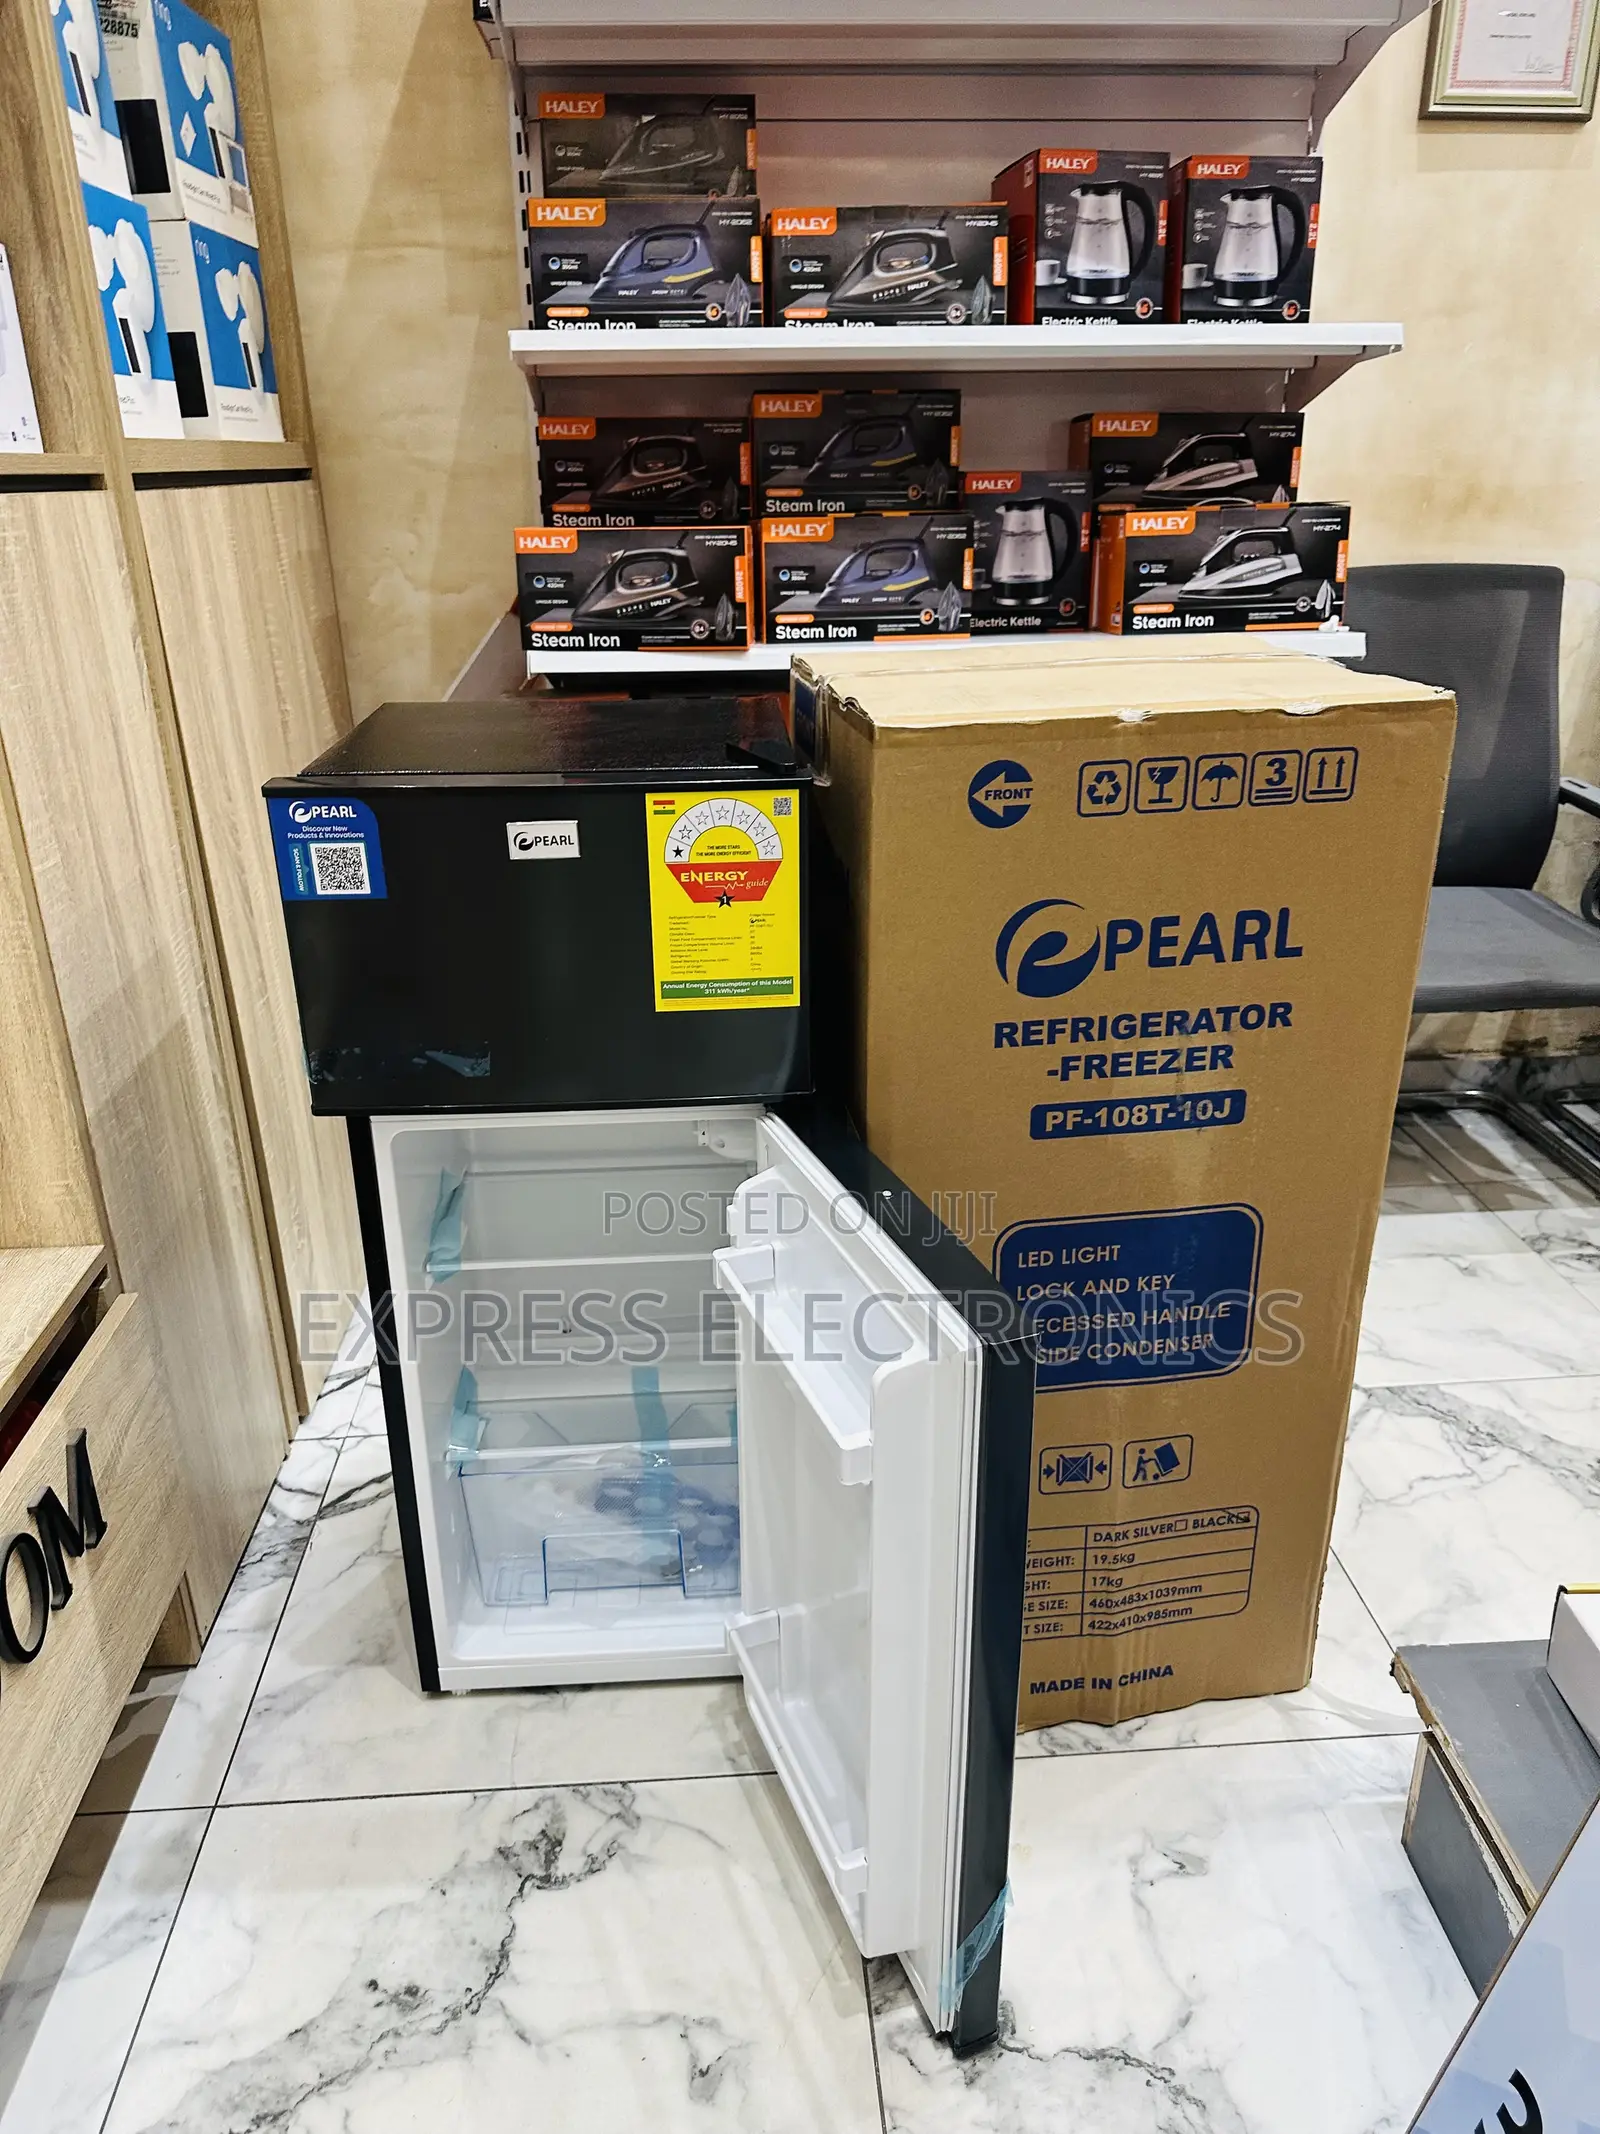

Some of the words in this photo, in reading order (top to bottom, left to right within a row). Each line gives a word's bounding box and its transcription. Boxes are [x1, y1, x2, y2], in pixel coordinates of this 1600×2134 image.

[545, 100, 599, 113] HALEY
[1046, 157, 1090, 170] HALEY
[1196, 163, 1242, 175] HALEY
[536, 205, 599, 221] HALEY
[777, 216, 832, 231] HALEY
[907, 281, 930, 292] HALEY
[761, 399, 816, 413] HALEY
[542, 424, 590, 435] HALEY
[1099, 419, 1152, 433] HALEY
[972, 479, 1015, 491] HALEY
[766, 499, 814, 513] Steam
[817, 498, 846, 512] Iron
[553, 514, 602, 527] Steam
[606, 513, 635, 527] Iron
[1132, 516, 1189, 531] HALEY
[771, 523, 828, 538] HALEY
[519, 536, 573, 549] HALEY
[650, 597, 672, 607] HALEY
[970, 616, 1008, 628] Electric
[1009, 615, 1042, 627] Kettle
[1132, 614, 1181, 630] Steam
[1184, 612, 1214, 628] Iron
[775, 625, 825, 640] Steam
[828, 623, 857, 638] Iron
[531, 633, 585, 648] Steam
[588, 632, 621, 648] Iron
[1264, 757, 1288, 787] 3
[984, 786, 1034, 801] FRONT
[311, 805, 357, 819] PEARL
[287, 832, 318, 840] Products
[534, 835, 574, 846] PEARL
[680, 870, 748, 885] ENERGY
[746, 878, 769, 889] guide
[722, 895, 727, 904] 1
[1104, 907, 1303, 971] PEARL
[686, 982, 708, 990] Energy
[708, 980, 751, 988] Consumption
[994, 1002, 1293, 1049] REFRIGERATOR
[1047, 1044, 1235, 1082] -FREEZER
[1045, 1096, 1232, 1132] PF-108T-10J
[1018, 1250, 1054, 1268] LED
[1061, 1245, 1121, 1265] LIGHT
[1017, 1280, 1076, 1301] LOCK
[1082, 1277, 1130, 1297] AND
[1137, 1274, 1176, 1291] KEY
[1143, 1302, 1232, 1324] HANDLE
[1037, 1344, 1081, 1365] SIDE
[1086, 1334, 1214, 1360] CONDENSER
[1094, 1531, 1130, 1543] DARK
[1133, 1523, 1174, 1539] SILVER
[1192, 1514, 1236, 1530] BLACK
[1092, 1552, 1136, 1566] 19.5kg
[1091, 1576, 1124, 1589] 17kg
[1024, 1602, 1034, 1613] E
[1038, 1599, 1069, 1612] SIZE:
[1089, 1583, 1203, 1609] 460x483x1039mm
[1034, 1622, 1064, 1634] SIZE:
[1087, 1605, 1193, 1631] 422x410x985mm
[1029, 1677, 1085, 1694] MADE
[1091, 1677, 1113, 1690] IN
[1117, 1664, 1174, 1688] CHINA
